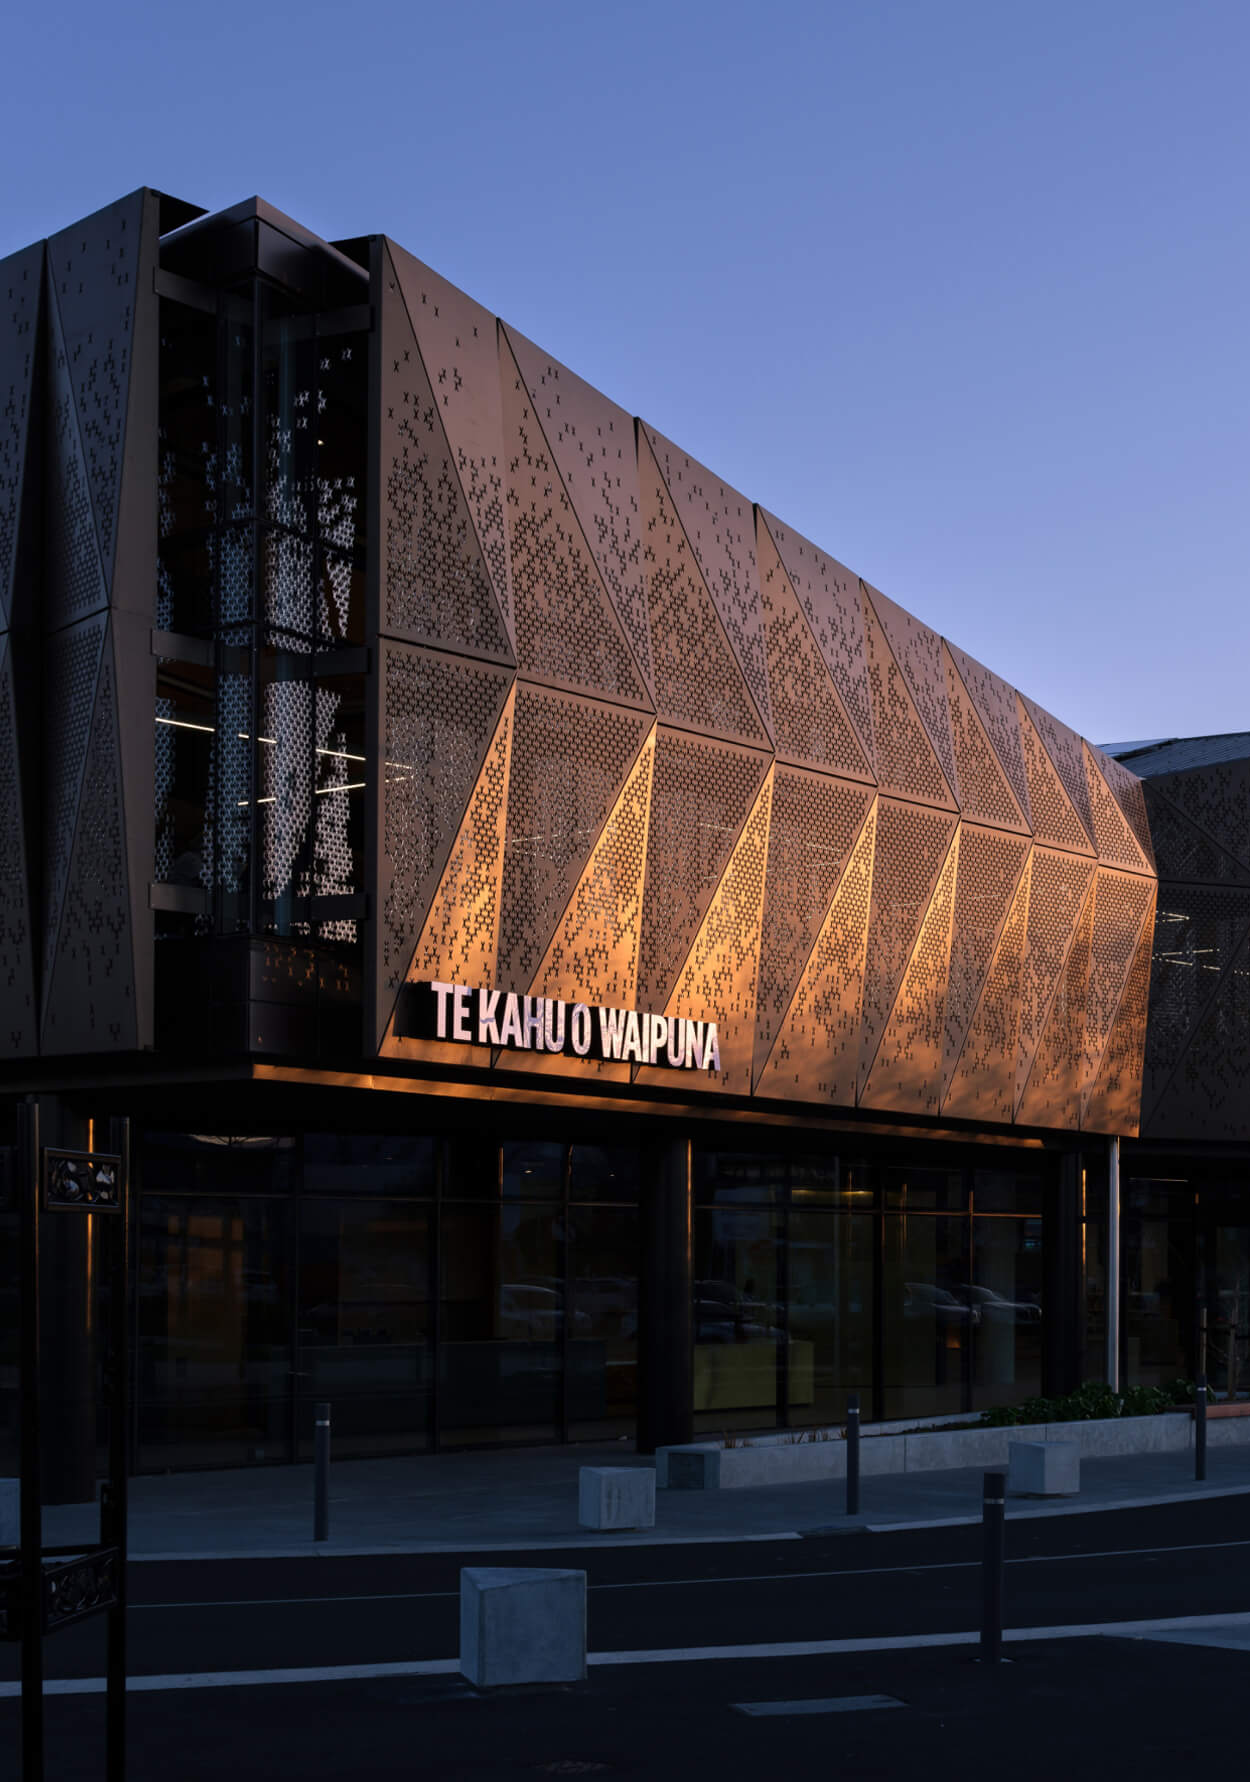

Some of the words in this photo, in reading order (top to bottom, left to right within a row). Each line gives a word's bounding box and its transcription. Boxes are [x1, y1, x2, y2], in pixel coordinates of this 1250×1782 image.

[431, 981, 472, 1041] TE
[478, 988, 566, 1053] KAHU
[571, 1003, 592, 1056] O
[598, 1006, 721, 1072] WAIPUNA
